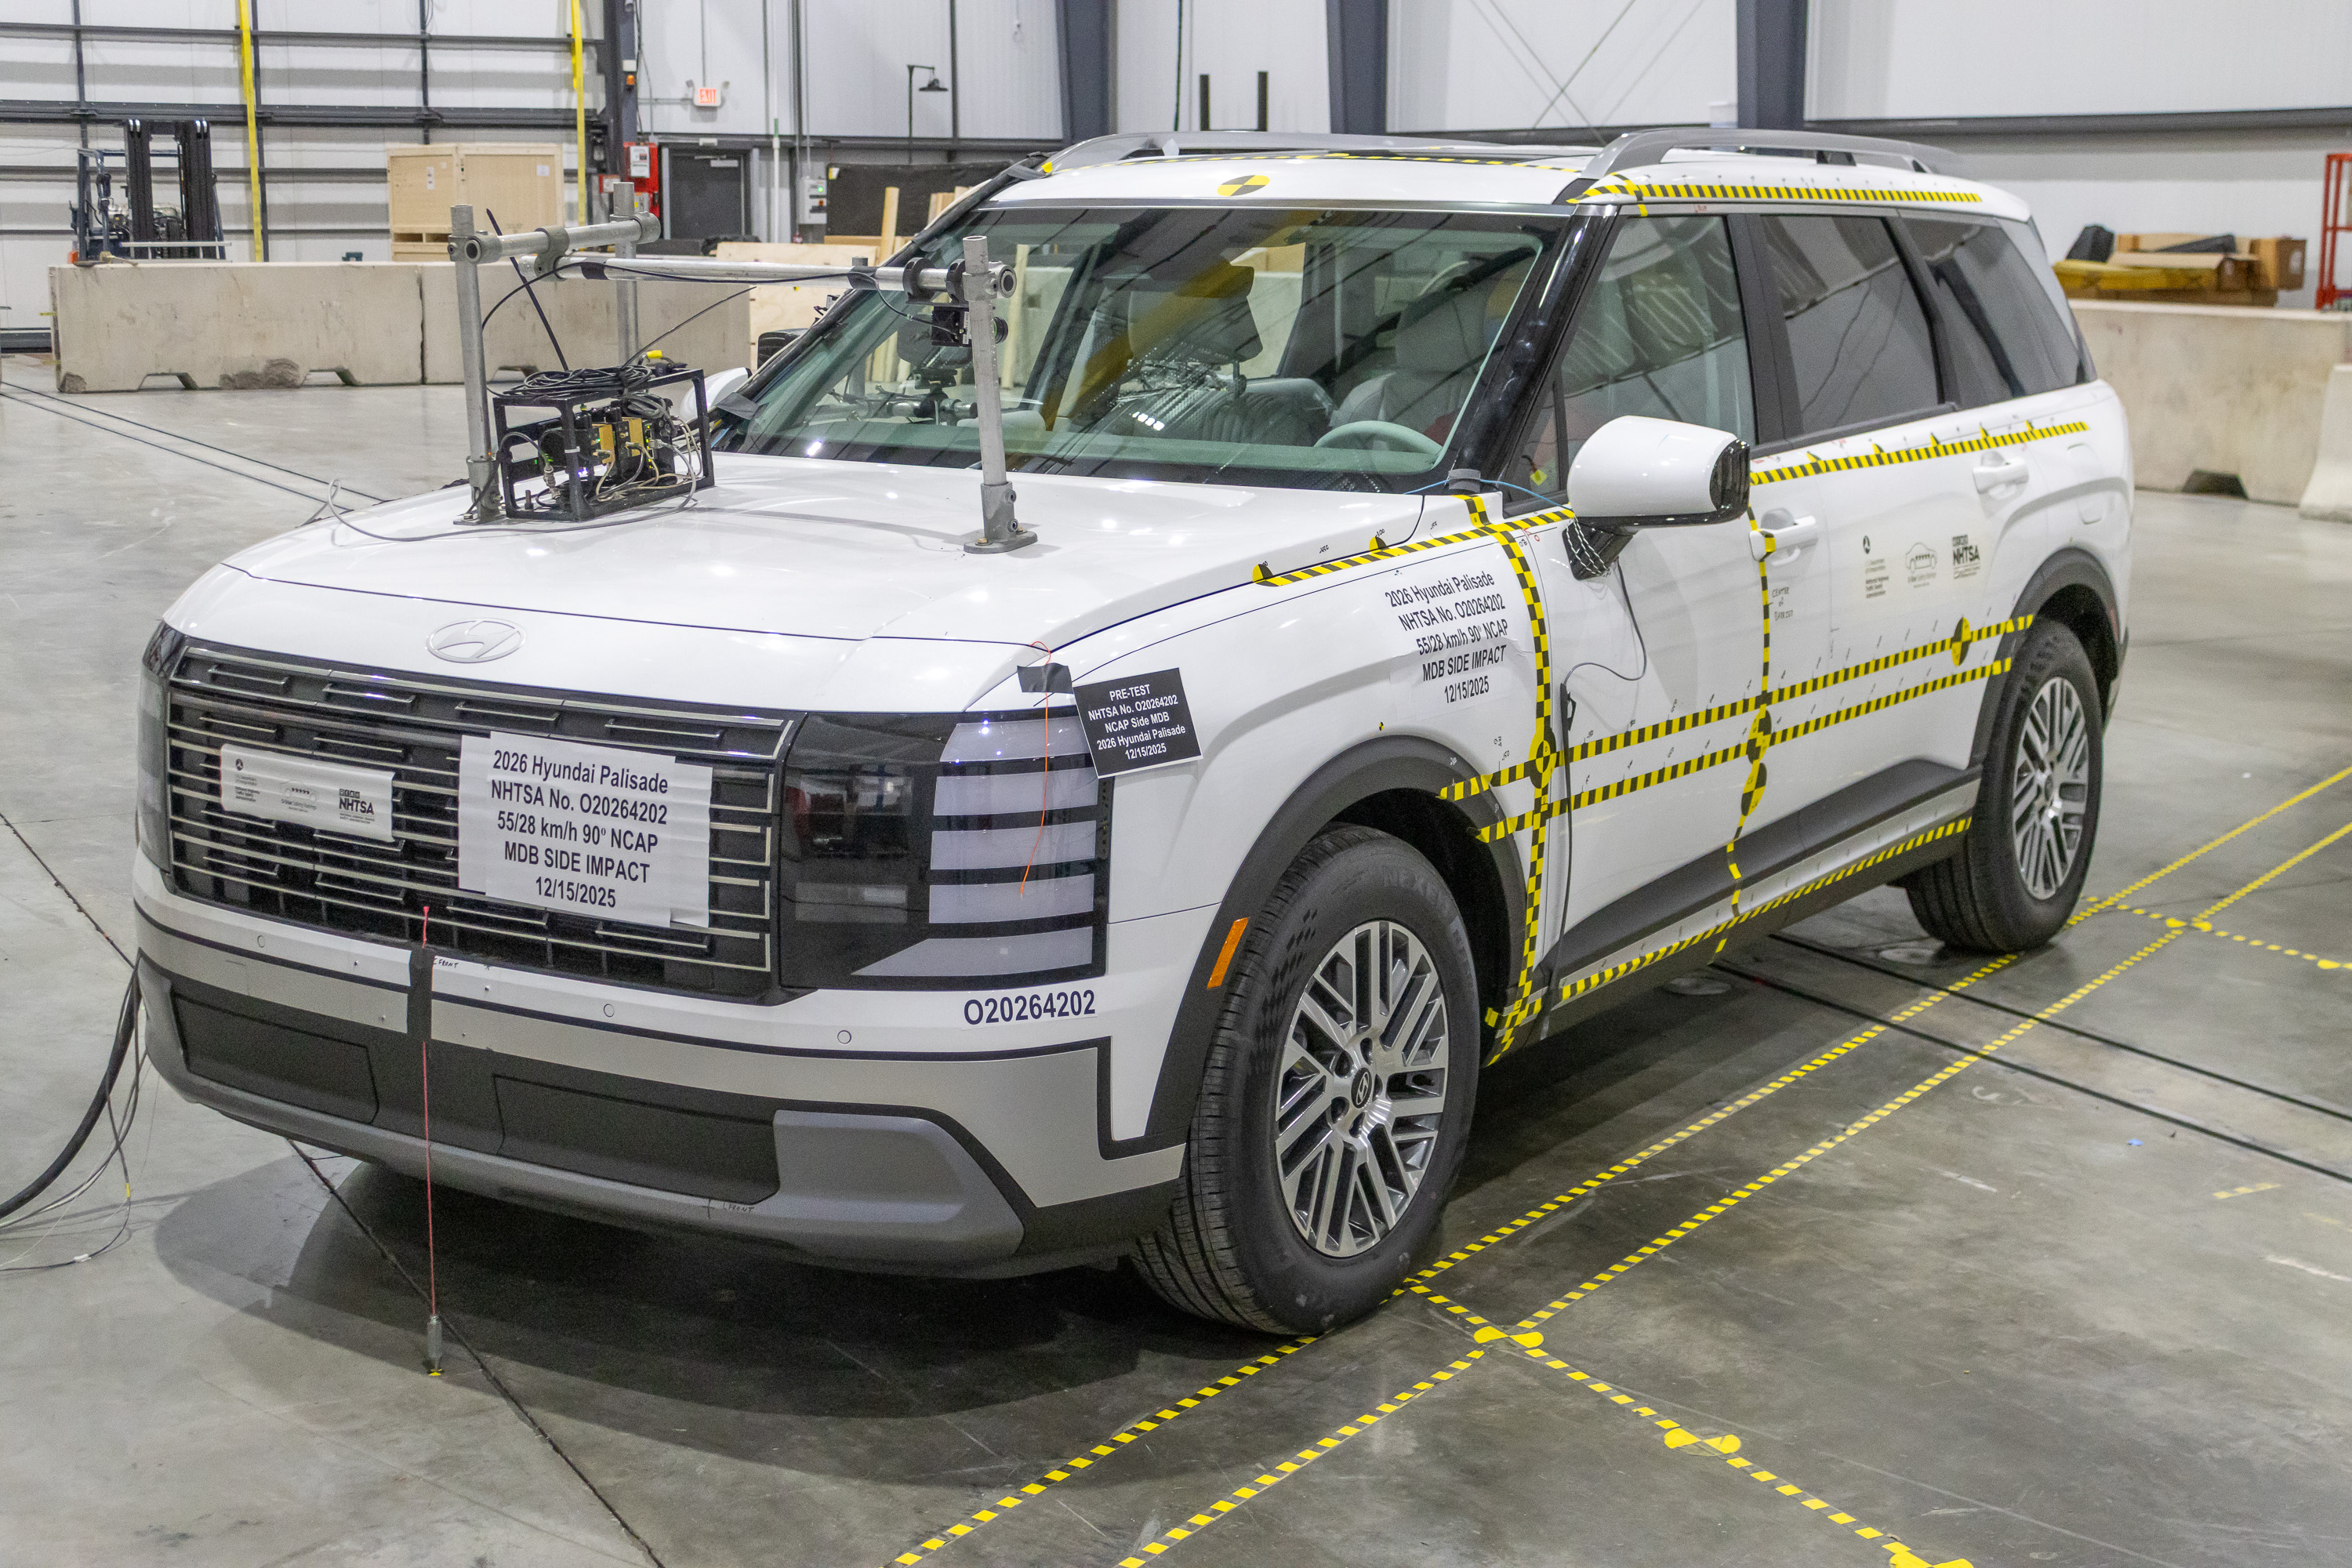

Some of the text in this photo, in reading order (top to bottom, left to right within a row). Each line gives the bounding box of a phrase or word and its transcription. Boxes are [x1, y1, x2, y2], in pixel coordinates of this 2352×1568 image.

[699, 89, 717, 103] EXIT
[1953, 546, 1980, 565] NHTSA
[1385, 571, 1494, 608] 2026 Hyundai Palisade
[1399, 593, 1505, 631] NHTSA No. O20264202
[1416, 633, 1443, 655] 55/28
[1443, 628, 1468, 649] km/h
[1484, 619, 1508, 639] NCAP
[1422, 644, 1507, 682] MDB SIDE IMPACT
[1109, 684, 1150, 701] PRE-TEST
[1444, 676, 1489, 703] 12/15/2025
[1088, 694, 1178, 721] NHTSA No. O20264202
[1105, 711, 1170, 733] NCAP Side MDB
[1097, 724, 1186, 750] 2026 Hyundai Palisade
[1125, 742, 1167, 760] 12/15/2025
[493, 750, 669, 794] 2026 Hyundai Palisade
[339, 797, 375, 815] NHTSA
[492, 779, 667, 825] NHTSA No. O20264202
[497, 811, 535, 835] 55/28
[541, 818, 577, 841] km/h
[611, 828, 659, 854] NCAP
[505, 841, 650, 884] MDB SIDE IMPACT
[535, 877, 616, 908] 12/15/2025
[439, 959, 459, 968] FRONT
[964, 989, 1095, 1025] O20264202
